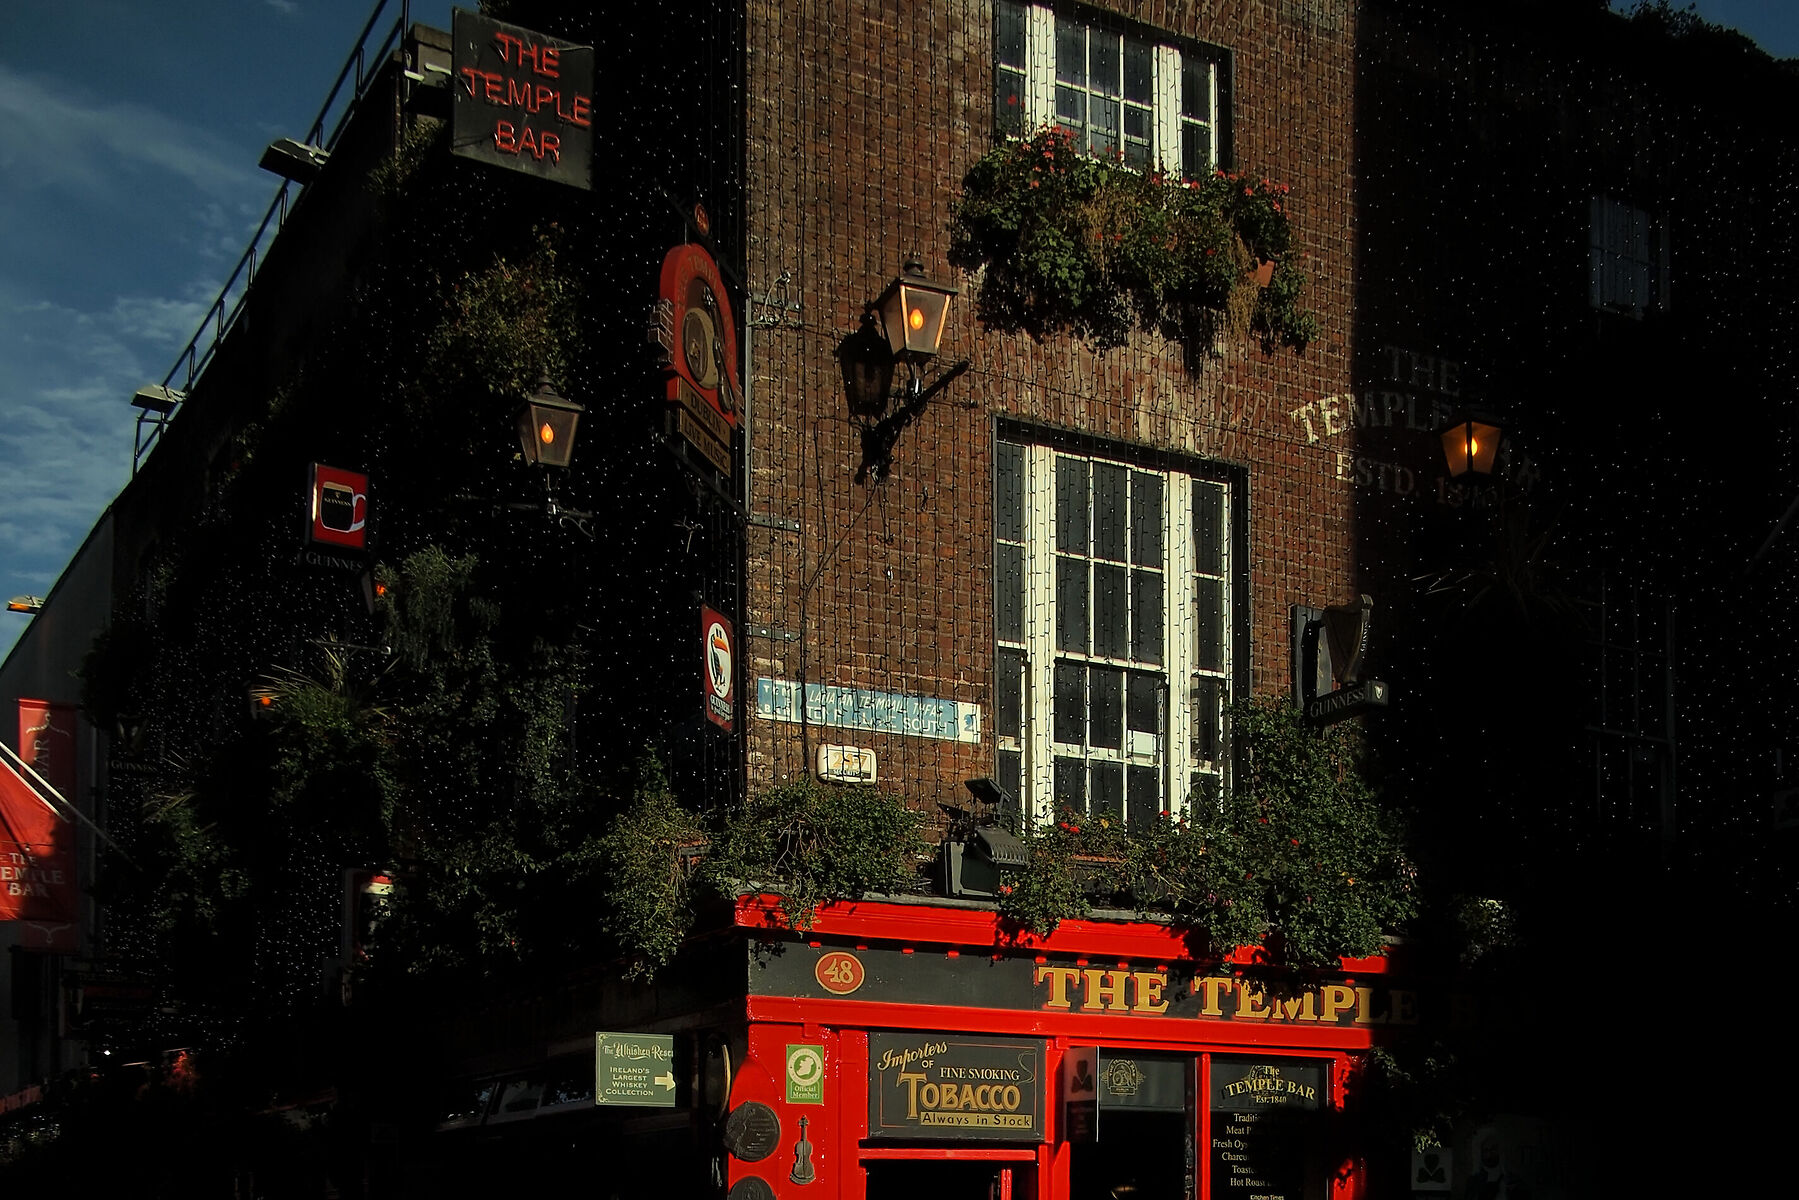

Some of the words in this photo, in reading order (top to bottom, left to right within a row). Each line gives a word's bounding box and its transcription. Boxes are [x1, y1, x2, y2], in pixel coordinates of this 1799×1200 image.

[494, 32, 560, 79] THE
[460, 66, 592, 127] TEMPLE
[496, 119, 561, 164] BAR
[1310, 688, 1365, 718] GUINNESS
[8, 881, 50, 899] BAR
[824, 958, 854, 984] 48
[1036, 966, 1170, 1015] THE
[1194, 972, 1418, 1026] TEMPLE
[613, 1042, 651, 1060] Whiskey
[877, 1041, 948, 1073] Importers
[610, 1066, 650, 1074] IRELAND'S
[921, 1059, 935, 1069] OF
[612, 1074, 648, 1082] LARGEST
[940, 1067, 967, 1079] FINE
[968, 1068, 1021, 1081] SMOKING
[605, 1088, 654, 1096] COLLECTION
[612, 1081, 648, 1089] WHISKEY
[1225, 1078, 1285, 1098] TEMPLE
[1286, 1081, 1316, 1100] BAR
[896, 1072, 1022, 1120] TOBACCO
[922, 1112, 970, 1126] Always
[976, 1115, 988, 1124] in
[993, 1114, 1031, 1126] Stock
[1212, 1138, 1233, 1149] Fresh
